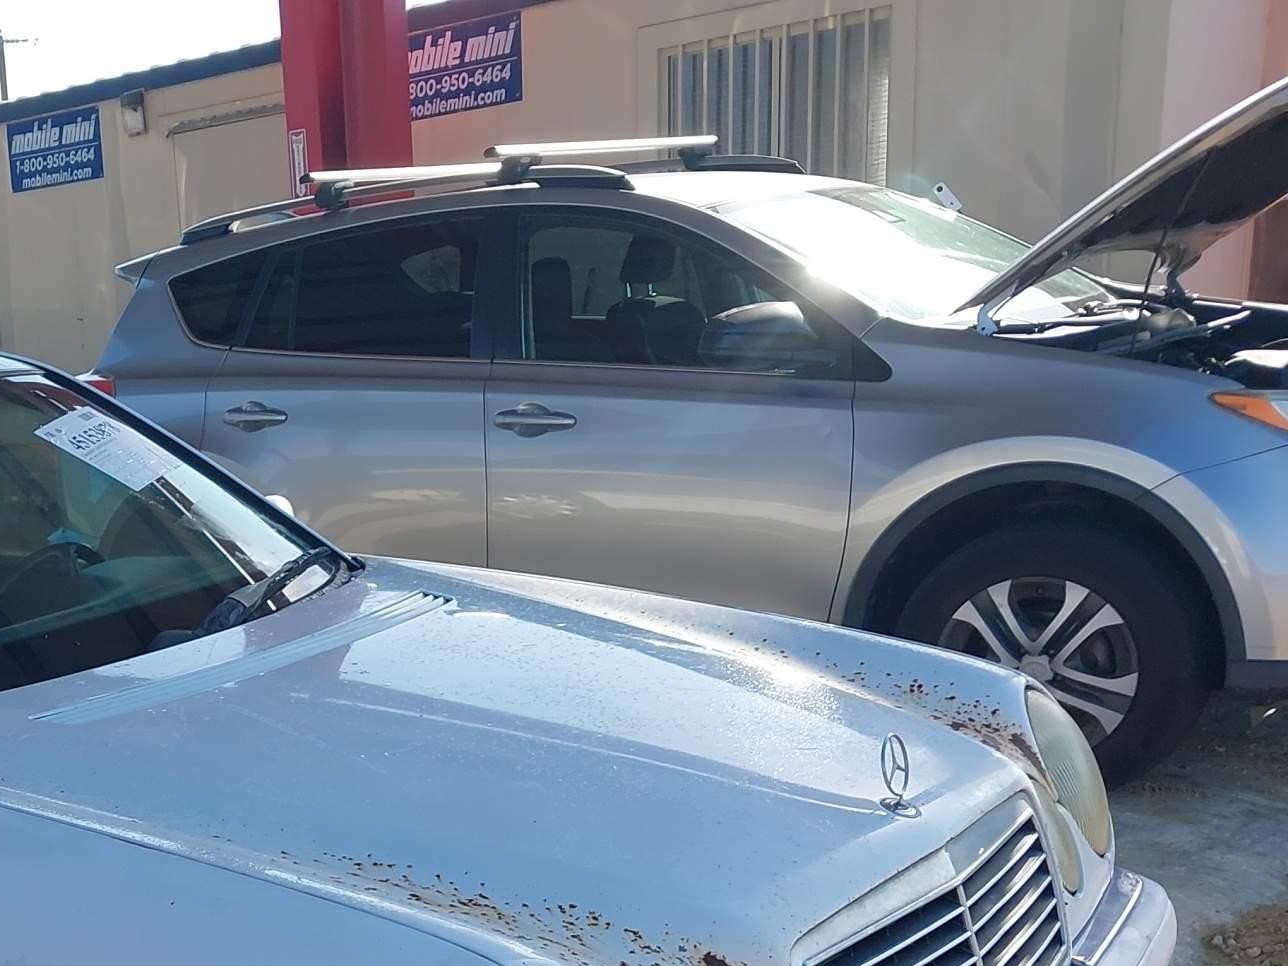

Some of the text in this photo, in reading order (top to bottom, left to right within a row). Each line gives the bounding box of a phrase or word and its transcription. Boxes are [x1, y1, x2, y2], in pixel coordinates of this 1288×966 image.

[464, 23, 516, 62] mini
[11, 114, 97, 154] mobile mini
[16, 147, 95, 174] 1-800-950-6464
[22, 168, 92, 189] mobilemini.com
